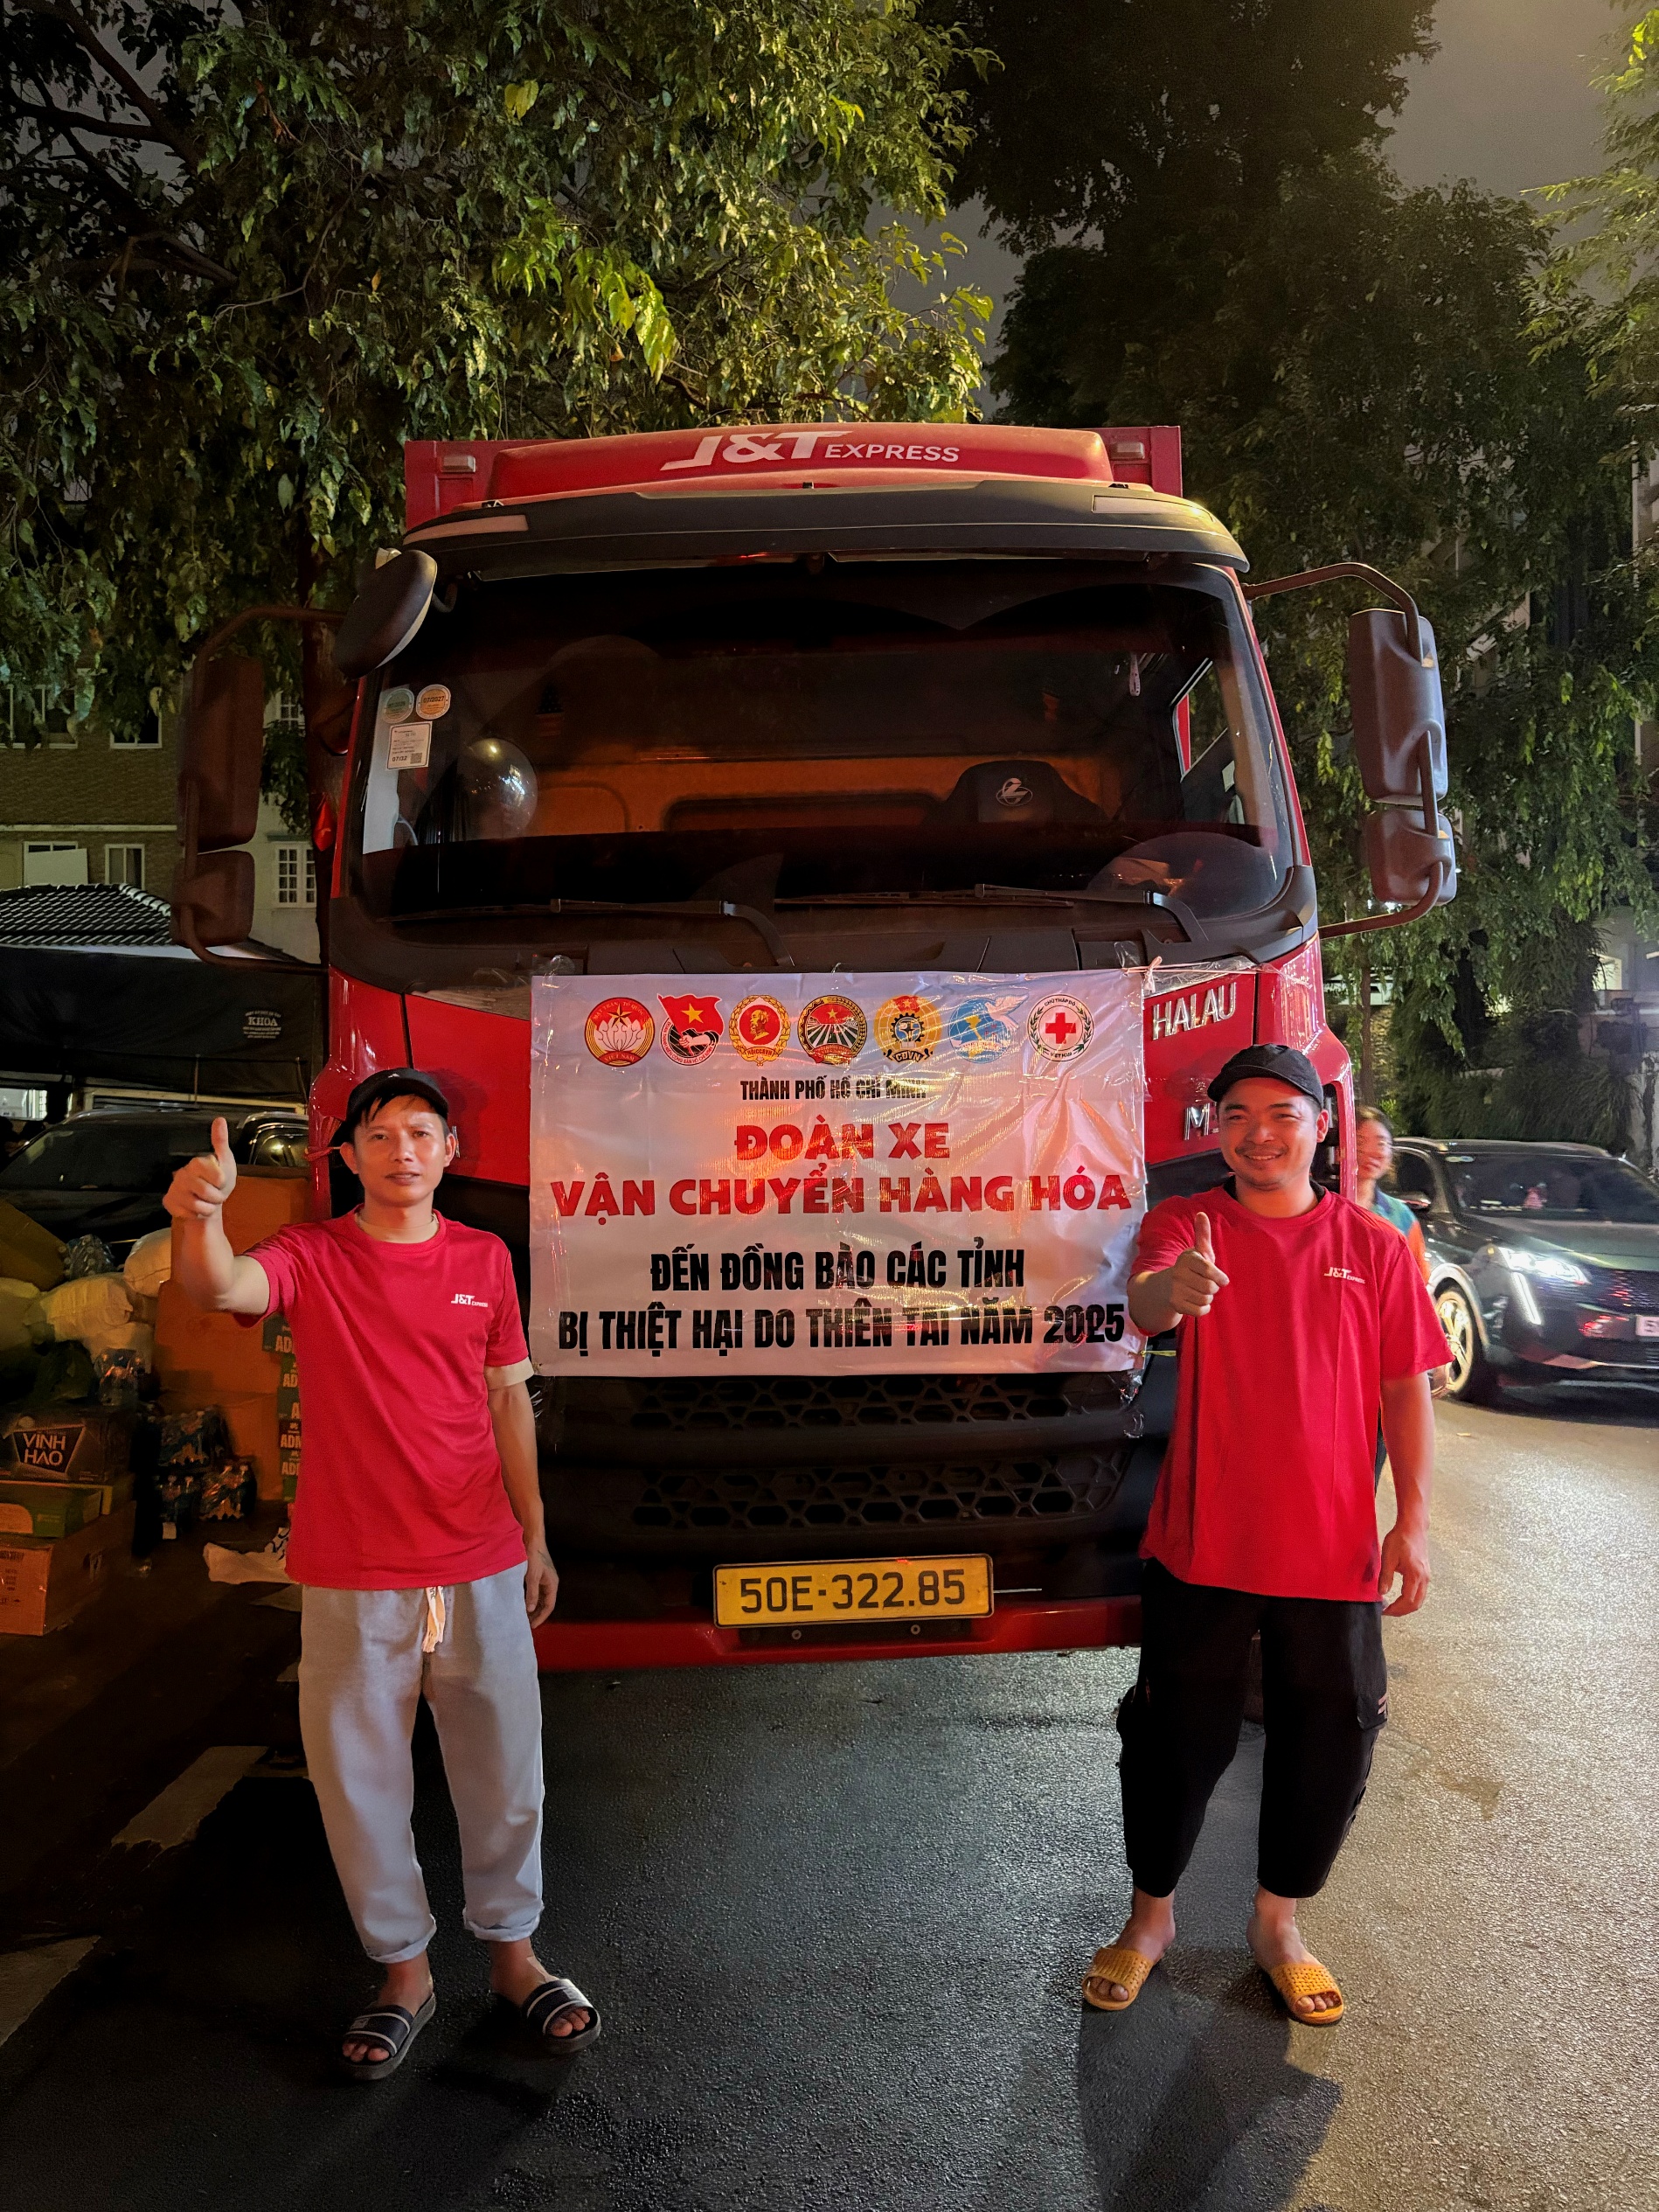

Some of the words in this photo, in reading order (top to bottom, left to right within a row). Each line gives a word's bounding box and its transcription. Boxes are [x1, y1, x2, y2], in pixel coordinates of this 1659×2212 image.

[660, 430, 854, 470] J&T
[824, 443, 960, 463] EXPRESS
[248, 1017, 278, 1026] KHOA
[1152, 982, 1237, 1040] HALAU
[740, 1077, 790, 1100] THÀNH
[795, 1075, 828, 1099] PHỐ
[830, 1076, 851, 1099] HỒ
[734, 1115, 874, 1160] ĐOÀN
[888, 1123, 950, 1159] XE
[551, 1172, 656, 1226] VẬN
[670, 1163, 864, 1216] CHUYỂN
[879, 1167, 1015, 1213] HÀNG
[1031, 1165, 1132, 1211] HÓA
[650, 1243, 710, 1291] ĐẾN
[720, 1243, 804, 1291] ĐỒNG
[816, 1242, 875, 1290] BÀO
[887, 1241, 947, 1288] CÁC
[957, 1236, 1025, 1288] TỈNH
[1324, 1267, 1352, 1279] J&T
[451, 1294, 475, 1304] J&T
[559, 1311, 589, 1357] BỊ
[599, 1302, 682, 1357] THIỆT
[692, 1309, 743, 1357] HẠI
[754, 1309, 795, 1349] DO
[805, 1297, 892, 1347] THIÊN
[902, 1306, 950, 1346] TAI
[960, 1297, 1033, 1345] NĂM
[1043, 1303, 1125, 1344] 2025
[740, 1569, 965, 1613] 50E-322.85
